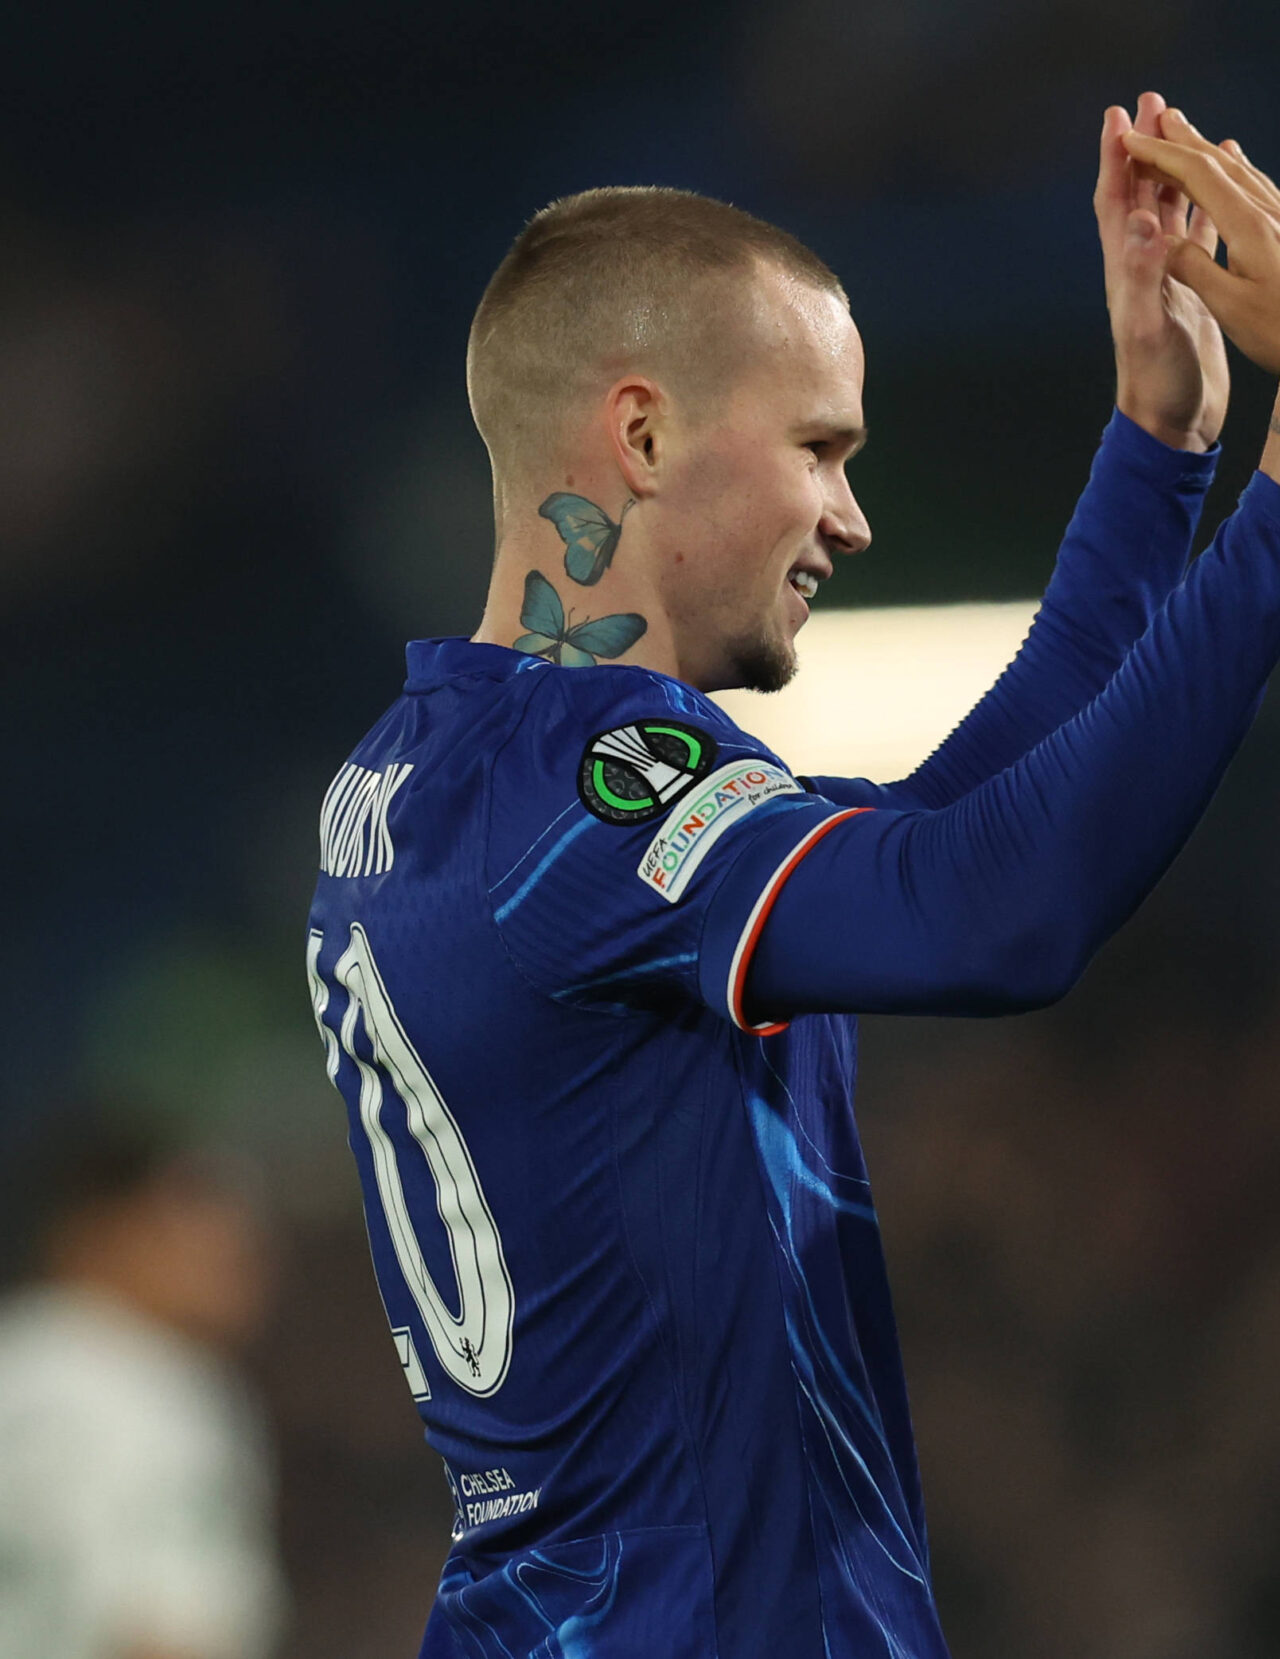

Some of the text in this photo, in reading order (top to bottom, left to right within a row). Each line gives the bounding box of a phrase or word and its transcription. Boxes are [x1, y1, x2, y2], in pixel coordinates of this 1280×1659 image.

[642, 838, 668, 877] UEFA
[460, 1467, 516, 1497] CHELSEA
[466, 1486, 542, 1527] FOUNDATION
